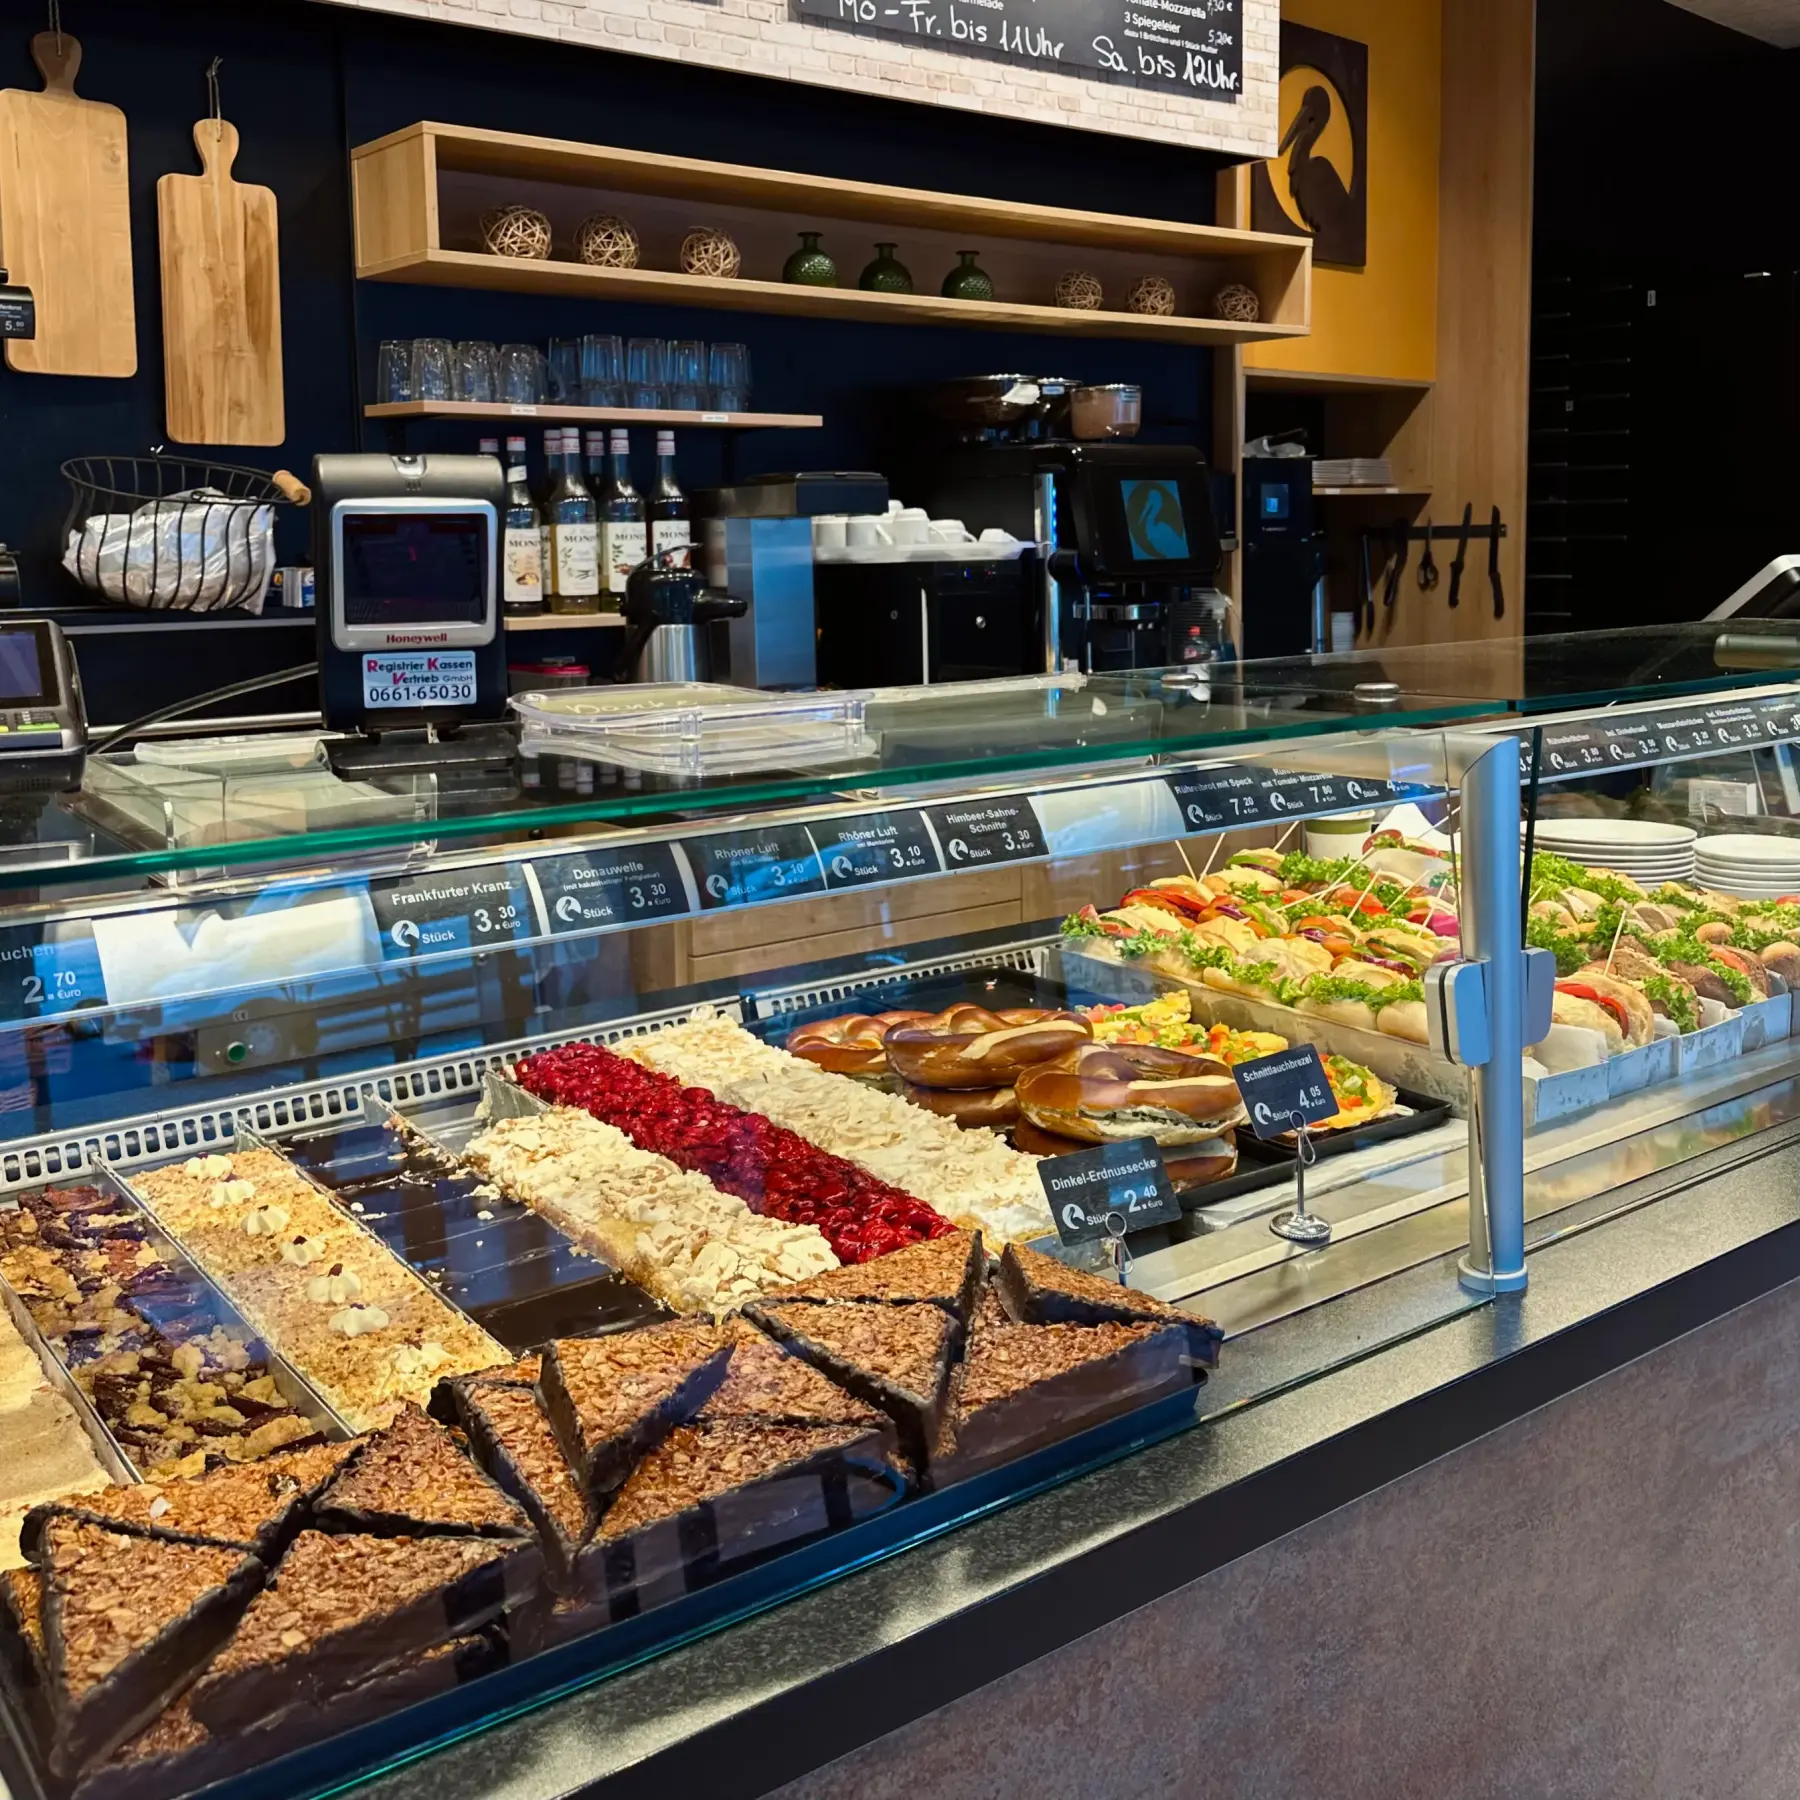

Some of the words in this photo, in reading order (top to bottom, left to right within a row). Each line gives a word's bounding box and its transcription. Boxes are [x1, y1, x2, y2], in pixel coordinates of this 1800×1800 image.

[839, 0, 877, 22] Mo
[902, 0, 942, 35] Fr.
[950, 5, 988, 42] bis
[1124, 11, 1131, 23] 3
[1132, 13, 1181, 33] Spiegeleier
[1138, 45, 1176, 78] bis
[386, 633, 448, 645] Honeywell
[367, 659, 424, 673] Registrier
[427, 657, 473, 671] Kassen
[392, 672, 439, 685] Vertrieb
[1216, 780, 1230, 789] mit
[1229, 777, 1253, 788] Speck
[1286, 800, 1304, 809] Stück
[946, 808, 1019, 824] Himbeer-Sahne-
[1204, 813, 1223, 822] Stück
[838, 830, 875, 842] Rhöner
[876, 825, 898, 837] Luft
[968, 821, 1007, 833] Schnitte
[757, 842, 780, 854] Luft
[969, 848, 992, 858] Stück
[573, 861, 644, 880] Donauwelle
[854, 864, 879, 876] Stück
[391, 885, 470, 906] Frankfurter
[472, 880, 513, 895] Kranz
[583, 906, 613, 919] Stück
[421, 930, 456, 944] Stück
[0, 946, 54, 961] uchen
[1242, 1053, 1313, 1082] Schnittlauchbrezel
[1271, 1109, 1291, 1121] Stück
[1051, 1158, 1157, 1191] Dinkel-Erdnussecke
